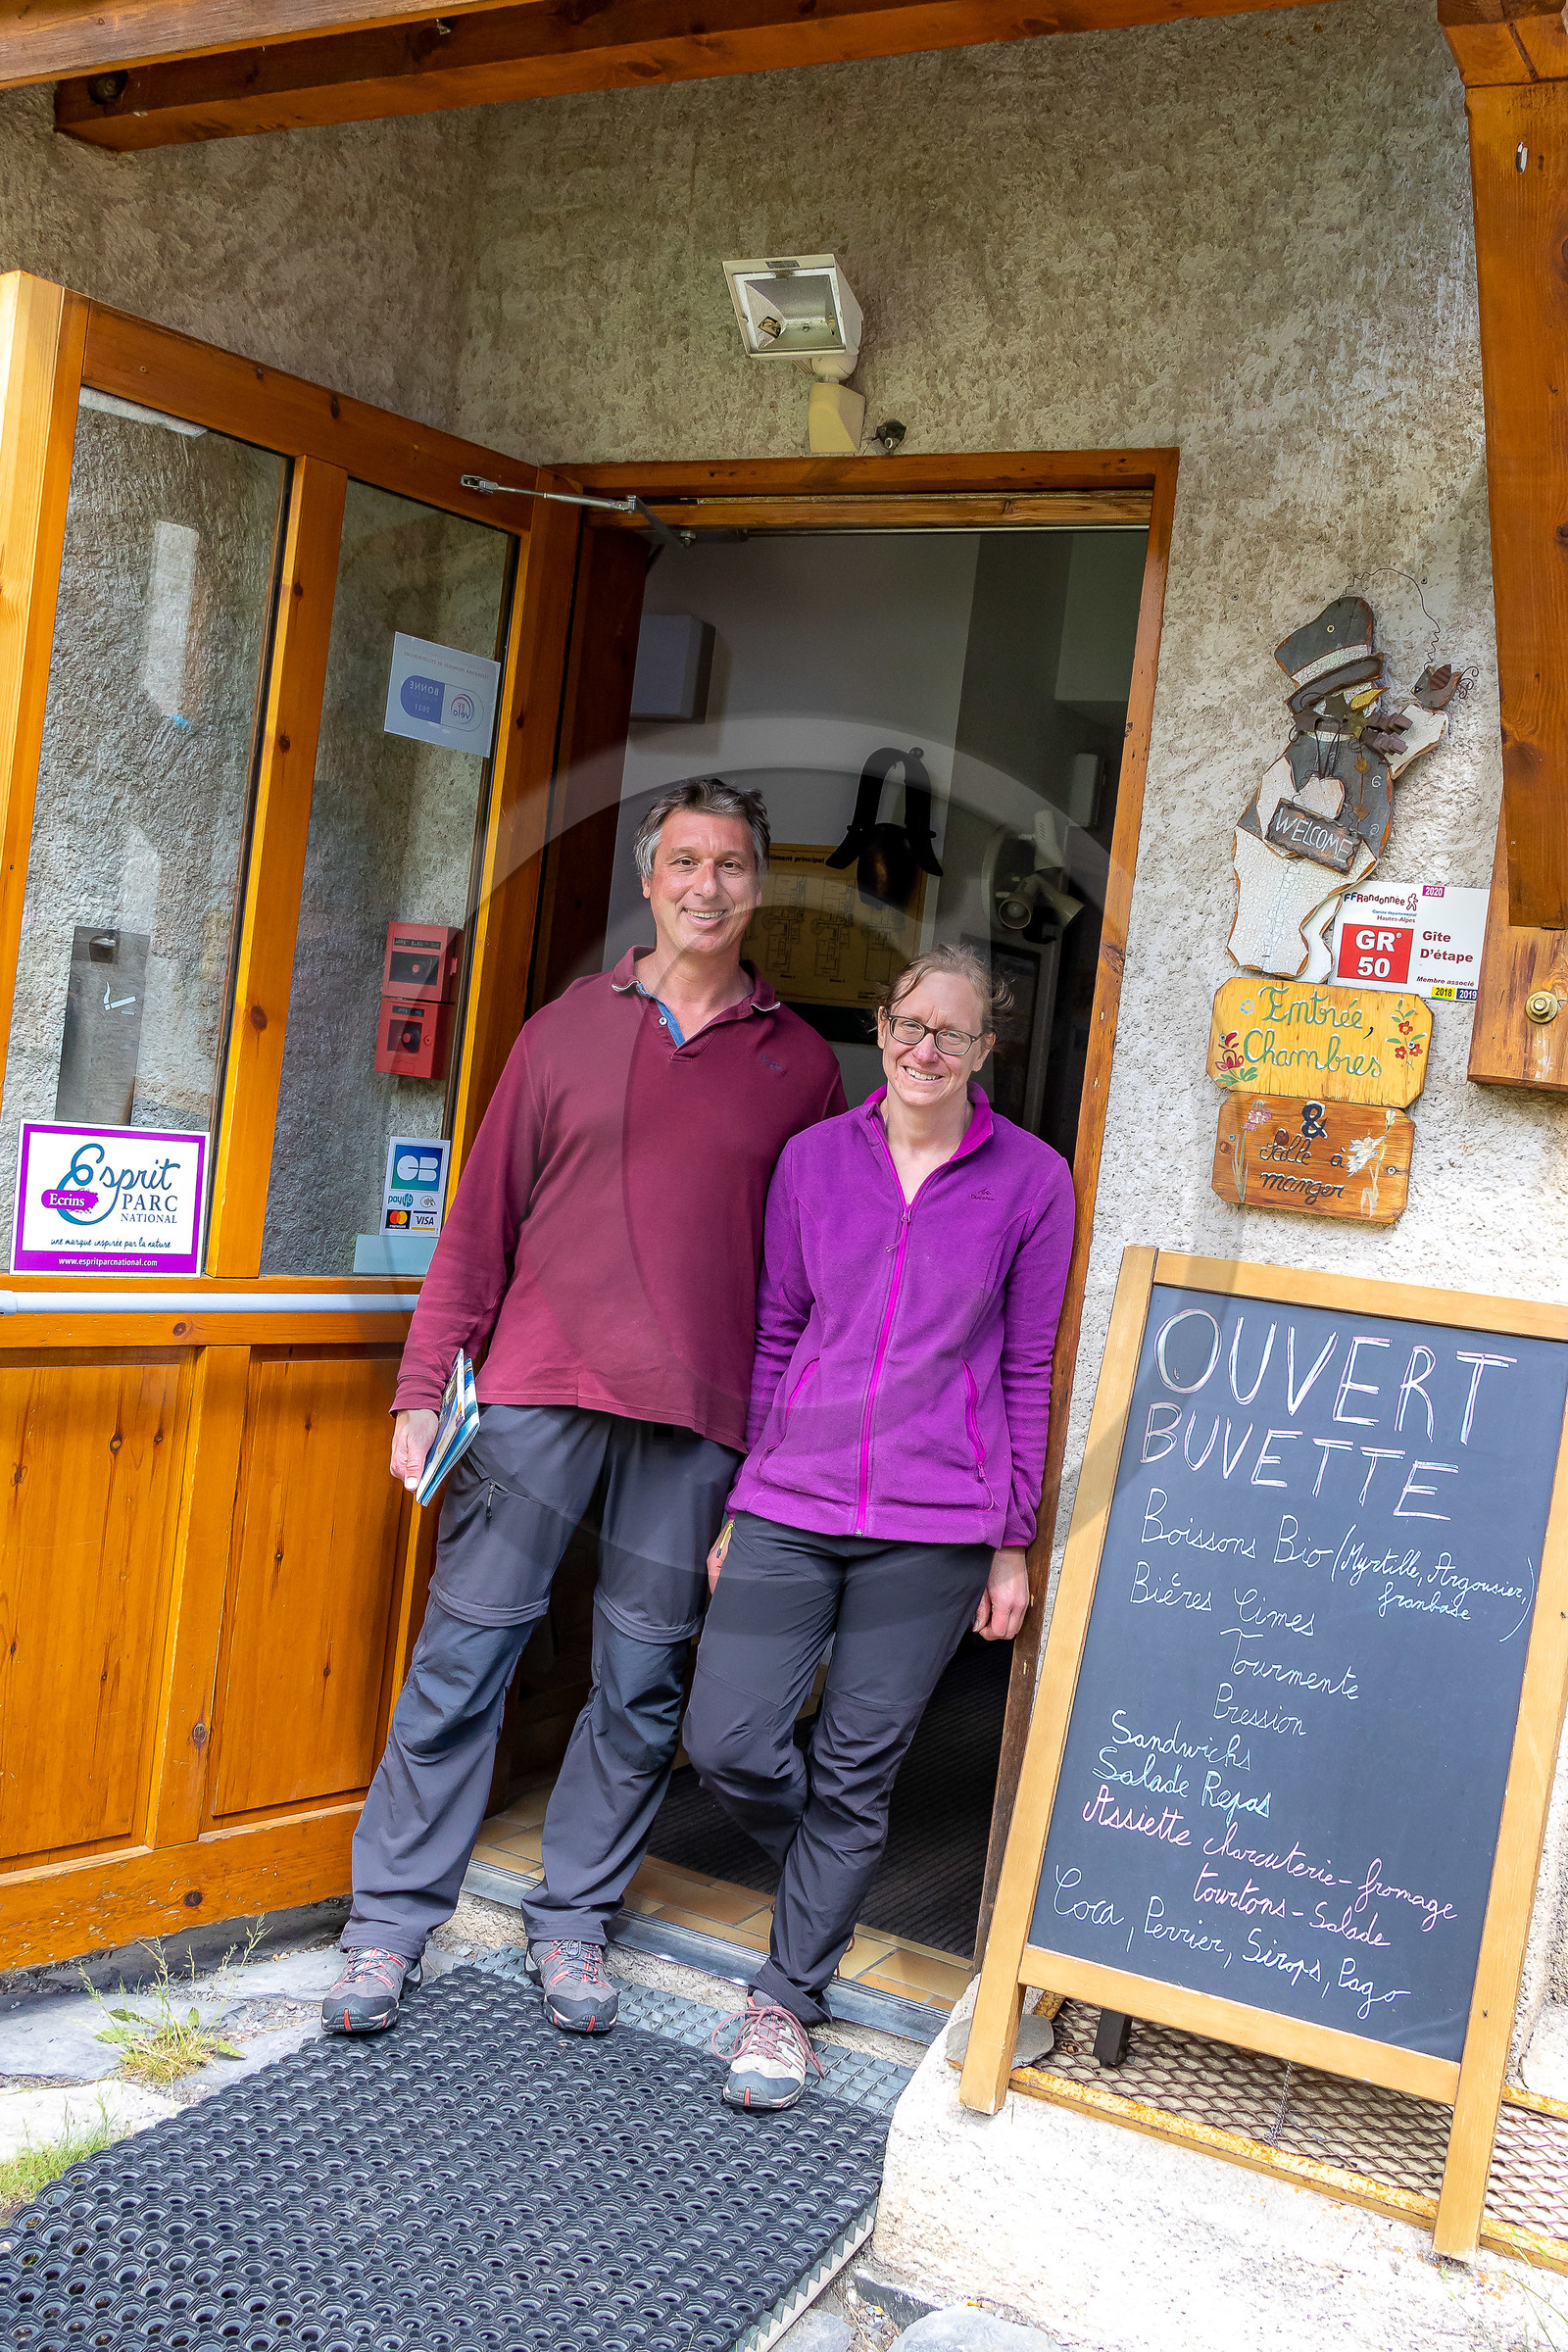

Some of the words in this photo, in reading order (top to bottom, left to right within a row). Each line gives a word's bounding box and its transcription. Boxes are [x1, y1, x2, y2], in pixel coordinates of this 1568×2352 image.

[1275, 807, 1356, 863] WELCOME
[794, 855, 825, 863] principal
[1424, 886, 1444, 897] 2020
[1422, 930, 1451, 943] Gîte
[1356, 956, 1391, 978] 50
[1416, 975, 1446, 985] Membre
[1435, 987, 1452, 998] 2018
[1458, 989, 1478, 1001] 2019
[1243, 1027, 1383, 1078] Chambres
[1300, 1100, 1329, 1141] &
[49, 1193, 86, 1207] Ecrins
[56, 1143, 181, 1225] Esprit
[122, 1193, 178, 1212] PARC
[1259, 1171, 1346, 1205] manger
[121, 1213, 178, 1224] NATIONAL
[416, 1215, 434, 1225] VISA
[58, 1256, 158, 1267] www.espritparcnational.com
[1153, 1308, 1518, 1446] OUVERT
[1140, 1401, 1459, 1521] BUVETTE
[1141, 1488, 1257, 1560] Boissons
[1220, 1628, 1360, 1701] Tourmente
[1212, 1682, 1308, 1738] Pression
[1110, 1709, 1252, 1772] Sandwichs
[1092, 1745, 1190, 1798] Salade
[1082, 1784, 1193, 1846] Assiette
